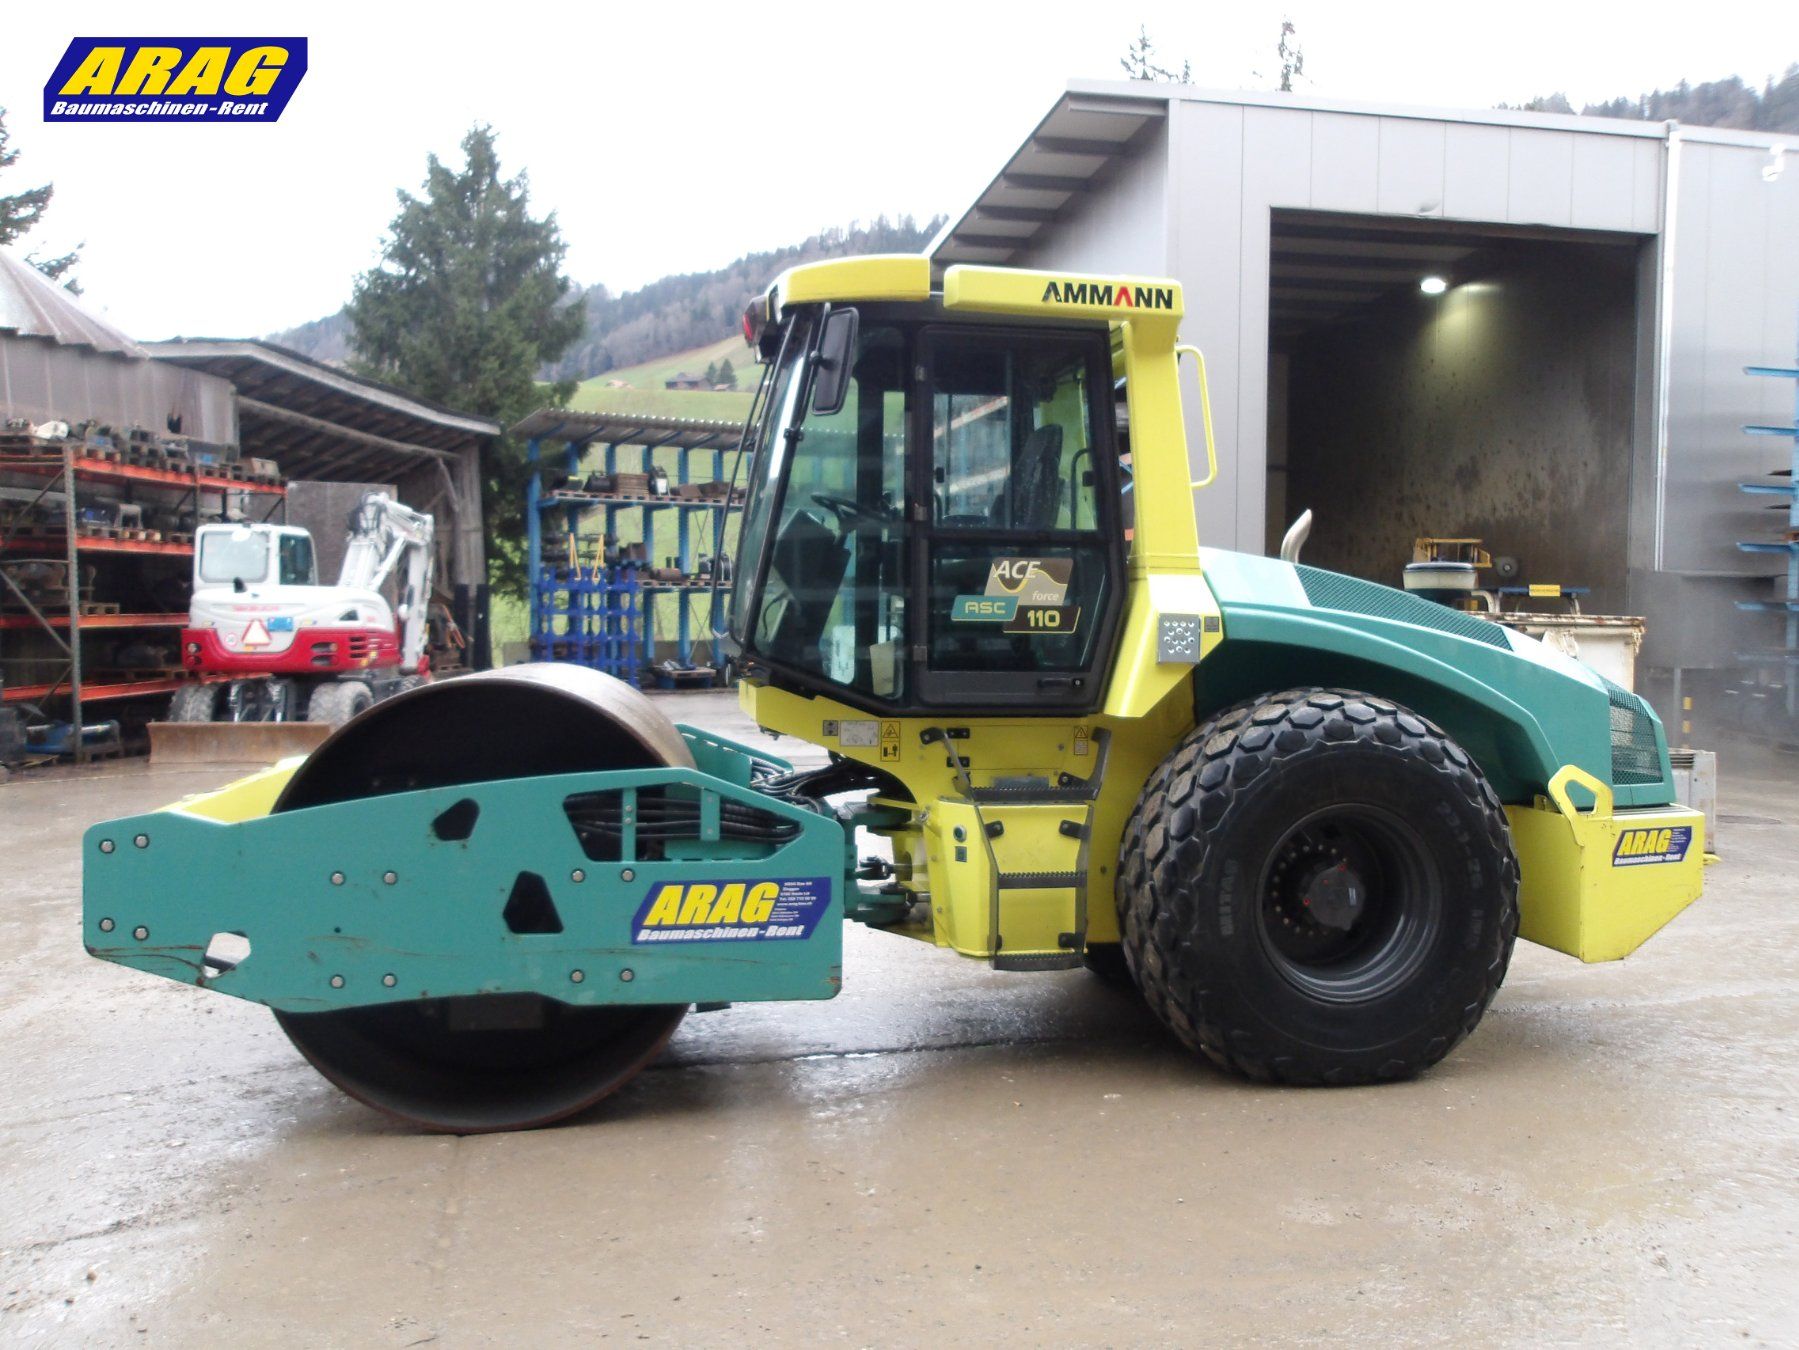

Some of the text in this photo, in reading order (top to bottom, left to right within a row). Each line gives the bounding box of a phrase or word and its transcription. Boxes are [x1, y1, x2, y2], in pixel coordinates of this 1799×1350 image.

[1041, 281, 1173, 310] AMMANN
[993, 560, 1042, 579] ACE
[1032, 590, 1060, 602] force
[964, 601, 1007, 614] ASC
[1027, 609, 1061, 628] 110
[1617, 829, 1671, 856] ARAG
[643, 882, 780, 926] ARAG
